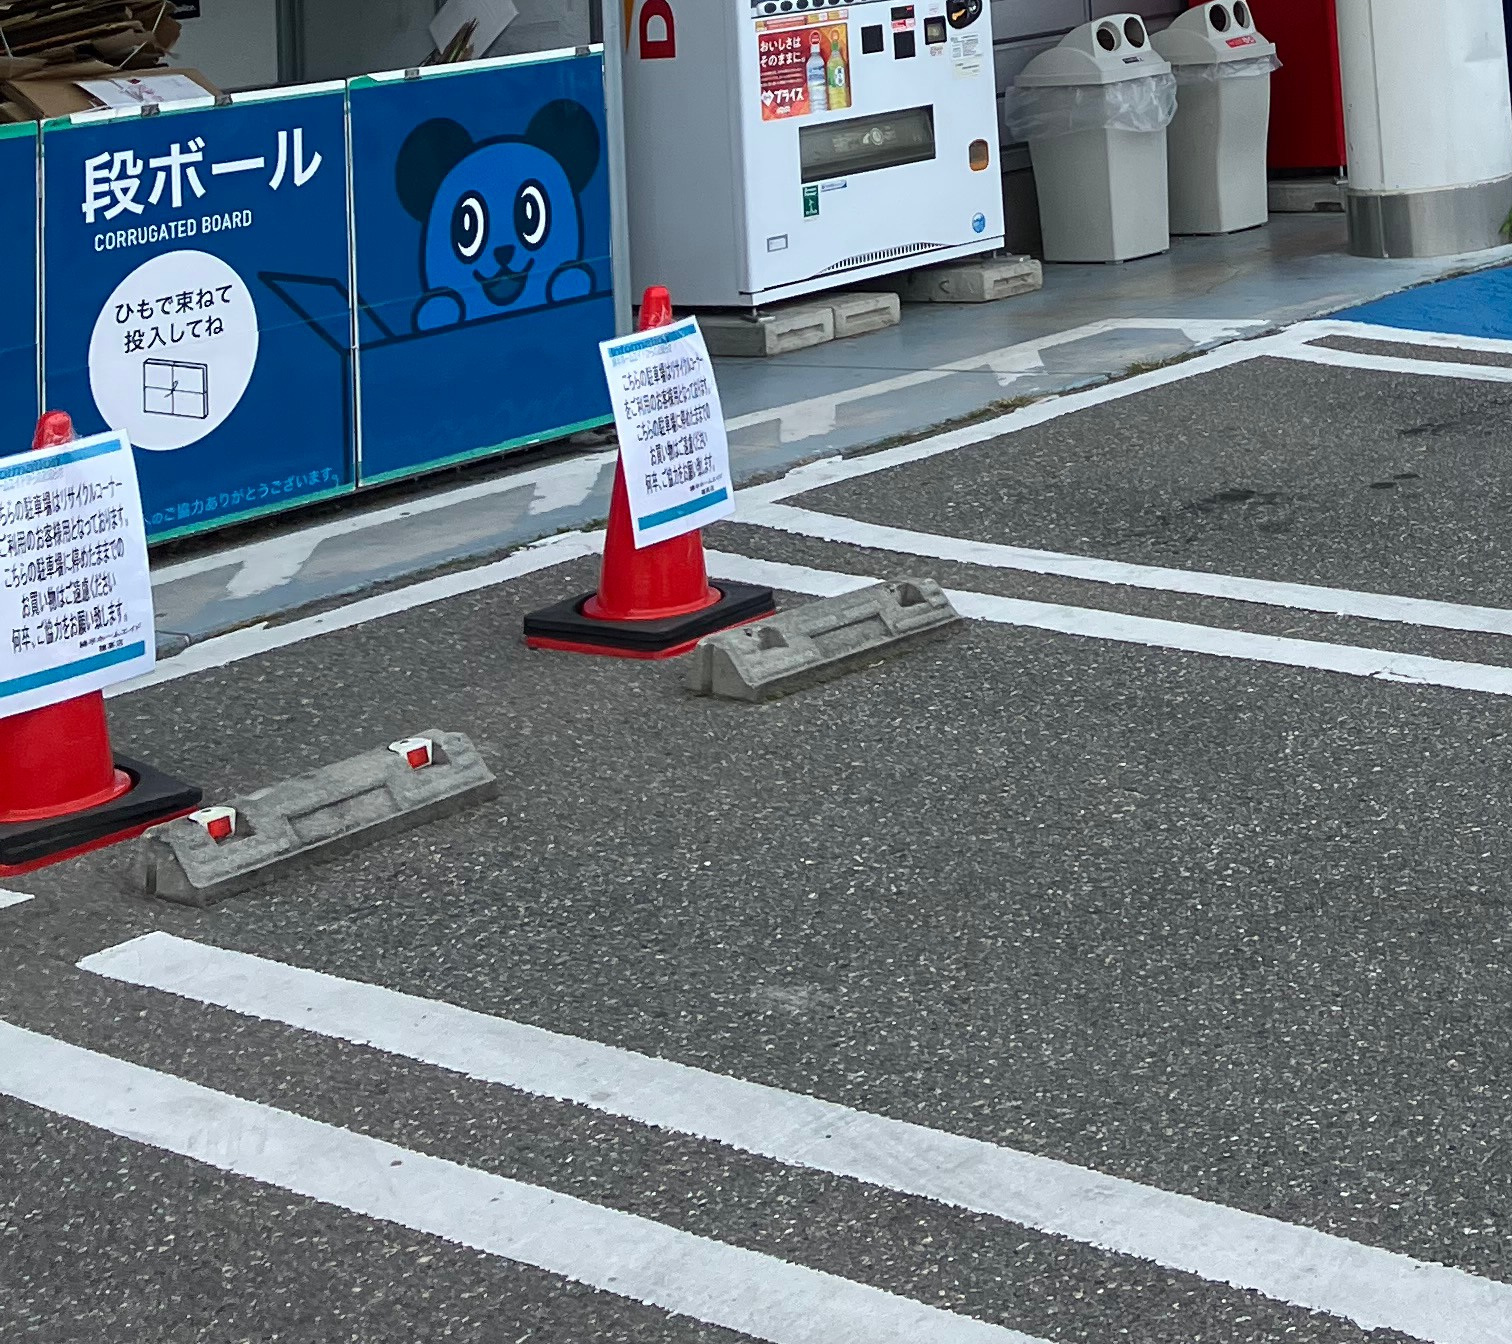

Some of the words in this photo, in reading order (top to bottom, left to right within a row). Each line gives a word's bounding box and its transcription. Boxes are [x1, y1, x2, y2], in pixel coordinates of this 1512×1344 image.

[81, 127, 323, 224] 段ボール
[94, 218, 197, 252] CORRUGATED
[201, 209, 252, 234] BOARD
[115, 284, 233, 324] ひもで束ねて
[124, 315, 225, 354] 投入してね
[144, 467, 340, 525] のご協力ありがとうございます。
